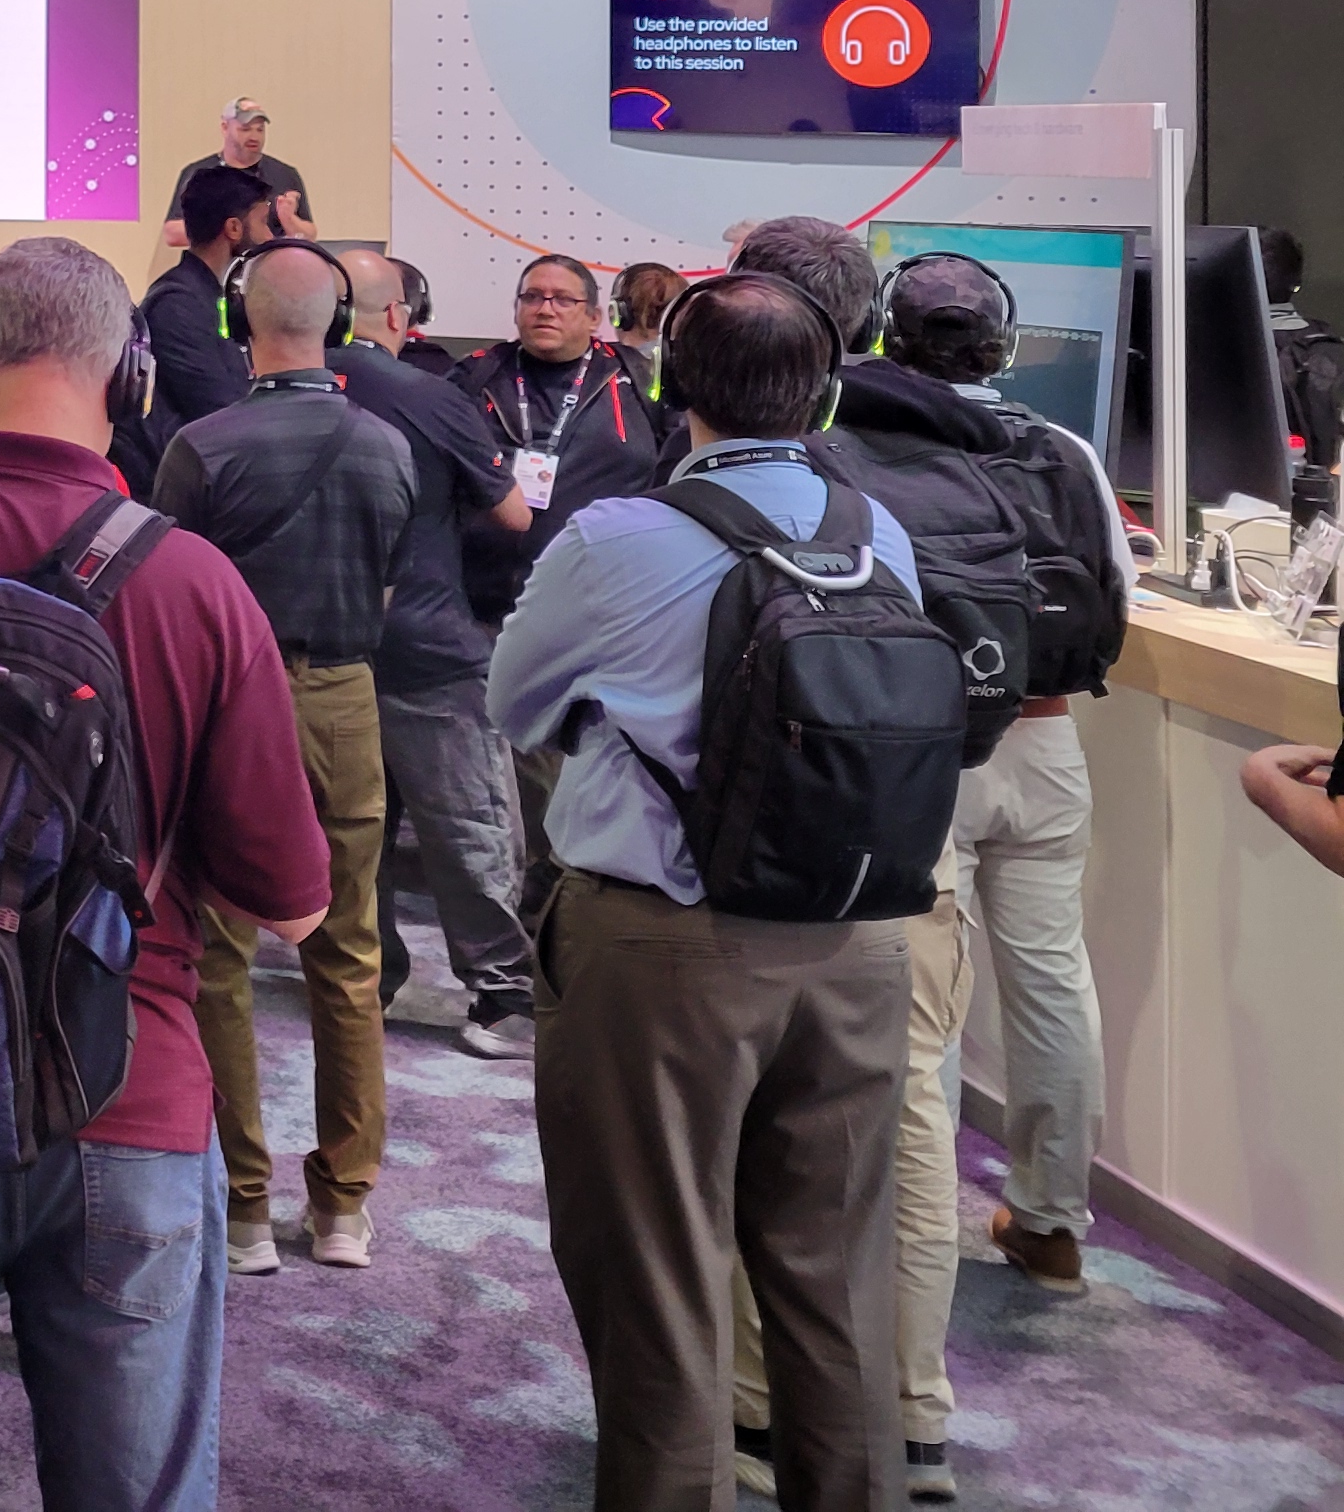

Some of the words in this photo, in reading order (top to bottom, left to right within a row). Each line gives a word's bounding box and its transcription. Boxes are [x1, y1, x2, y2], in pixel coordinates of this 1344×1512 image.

[633, 17, 666, 32] Use
[668, 16, 695, 32] the
[697, 16, 769, 35] provided
[634, 35, 732, 54] headphones
[734, 37, 752, 51] to
[754, 37, 798, 51] listen
[634, 56, 653, 70] to
[654, 55, 684, 70] this
[685, 55, 744, 70] session
[967, 684, 1006, 698] elon
